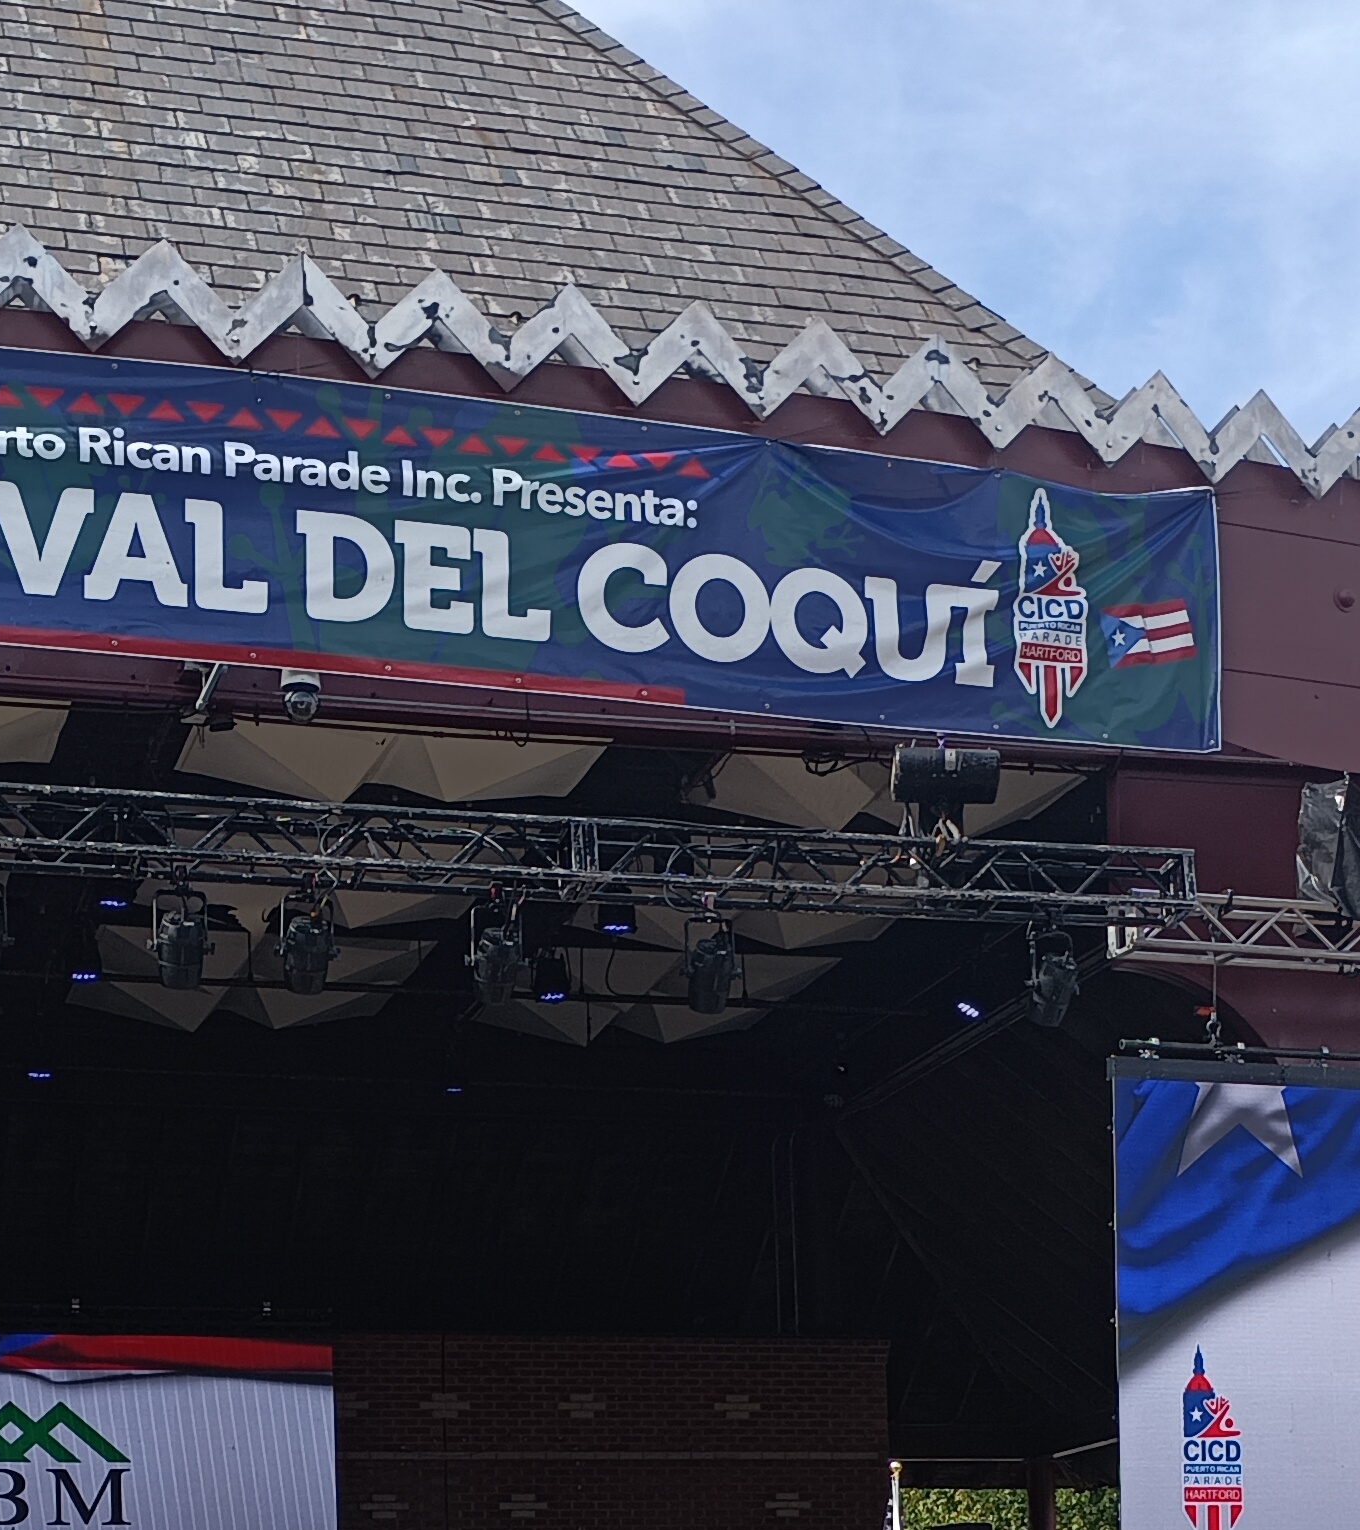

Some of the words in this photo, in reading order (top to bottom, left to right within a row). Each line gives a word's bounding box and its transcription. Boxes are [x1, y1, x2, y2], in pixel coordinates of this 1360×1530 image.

[79, 427, 211, 474] Rican
[224, 441, 390, 494] Parade
[402, 460, 481, 504] Inc.
[492, 469, 698, 528] Presenta:
[296, 509, 551, 642] DEL
[577, 542, 1002, 687] COQUÍ
[1018, 595, 1084, 620] CICD
[1019, 631, 1082, 647] PARADE
[1022, 645, 1080, 662] HARTFORD
[1183, 1439, 1241, 1461] CICD
[1184, 1475, 1242, 1486] PARADE
[1185, 1489, 1240, 1500] HARTFORD
